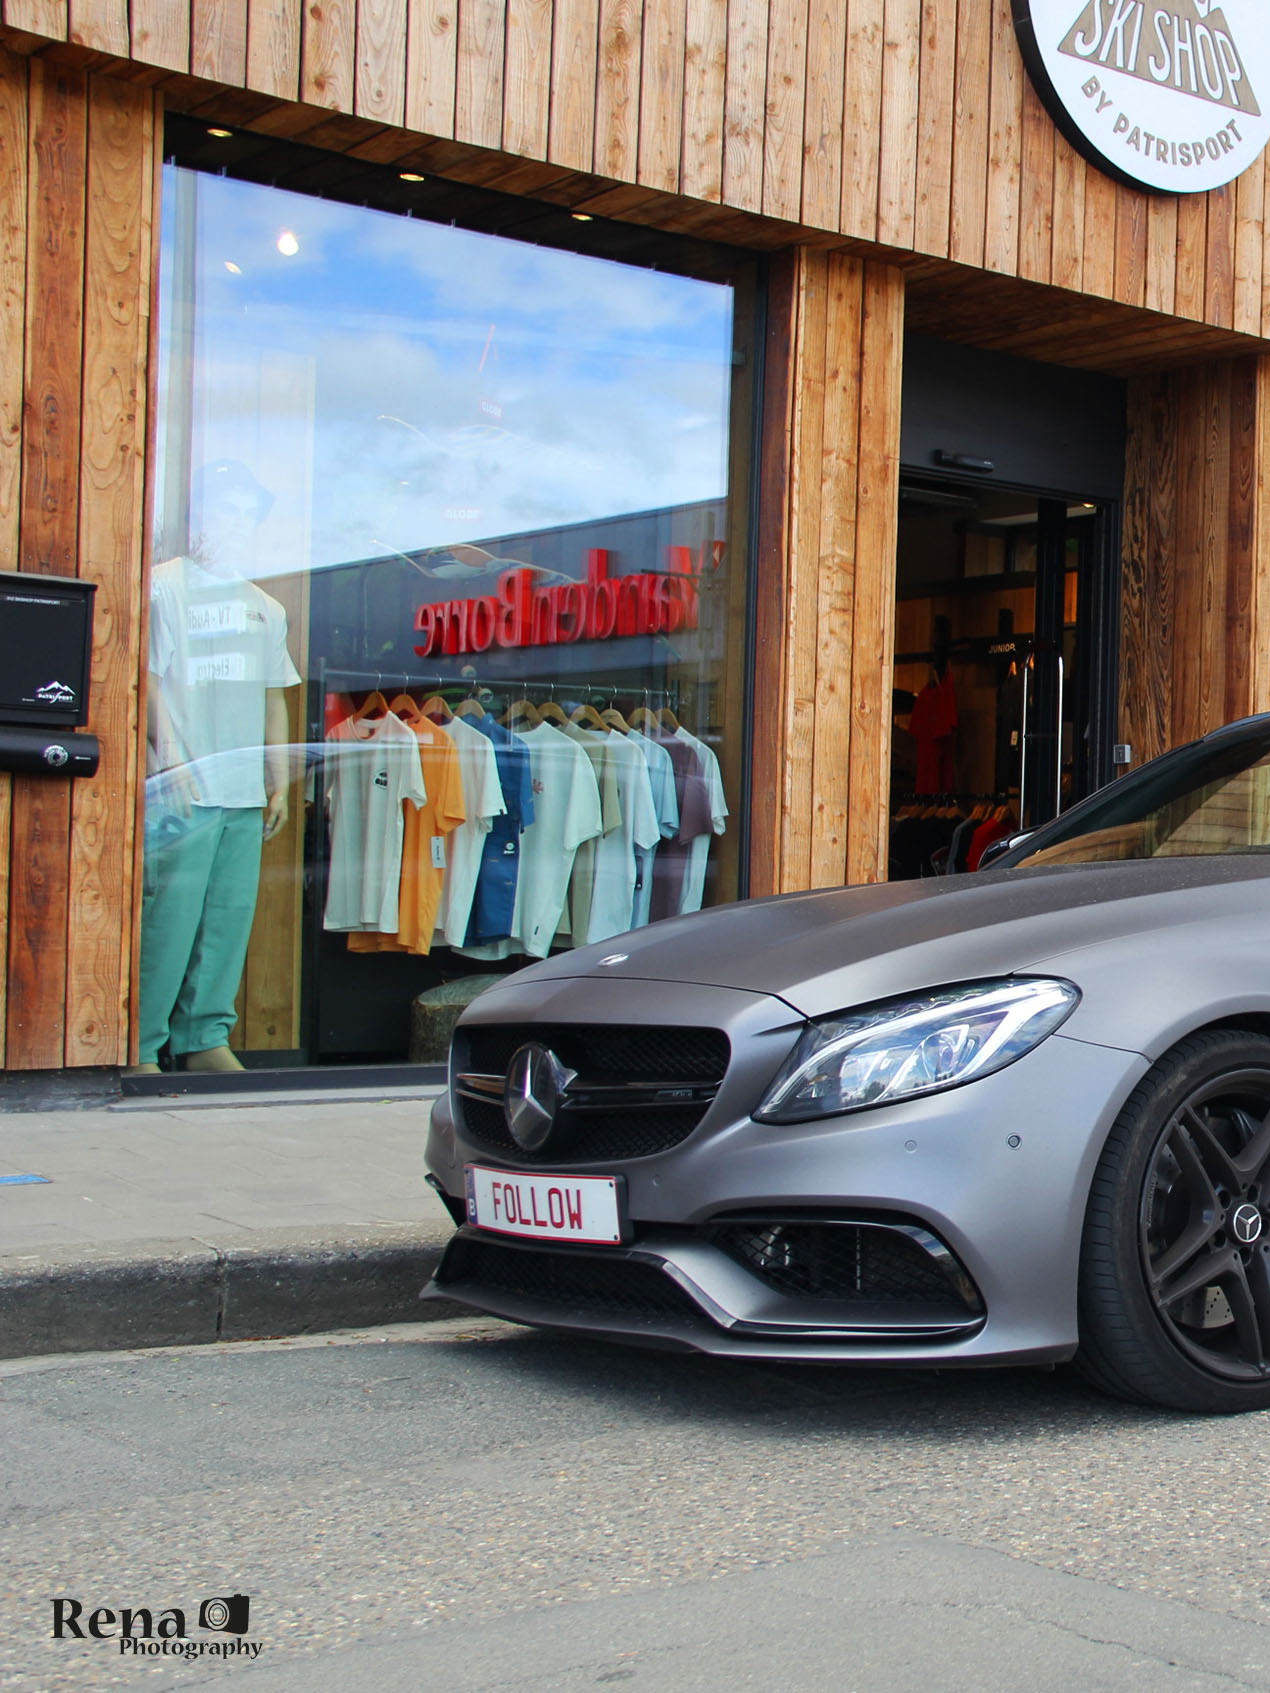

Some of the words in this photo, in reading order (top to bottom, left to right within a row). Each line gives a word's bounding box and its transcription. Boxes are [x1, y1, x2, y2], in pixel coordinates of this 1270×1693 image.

[1075, 0, 1143, 72] SKI
[1148, 10, 1242, 106] SHOP
[1081, 76, 1113, 113] BY
[1113, 113, 1243, 166] PATRISPORT
[988, 642, 1016, 654] JUNIOR
[492, 1181, 582, 1230] FOLLOW
